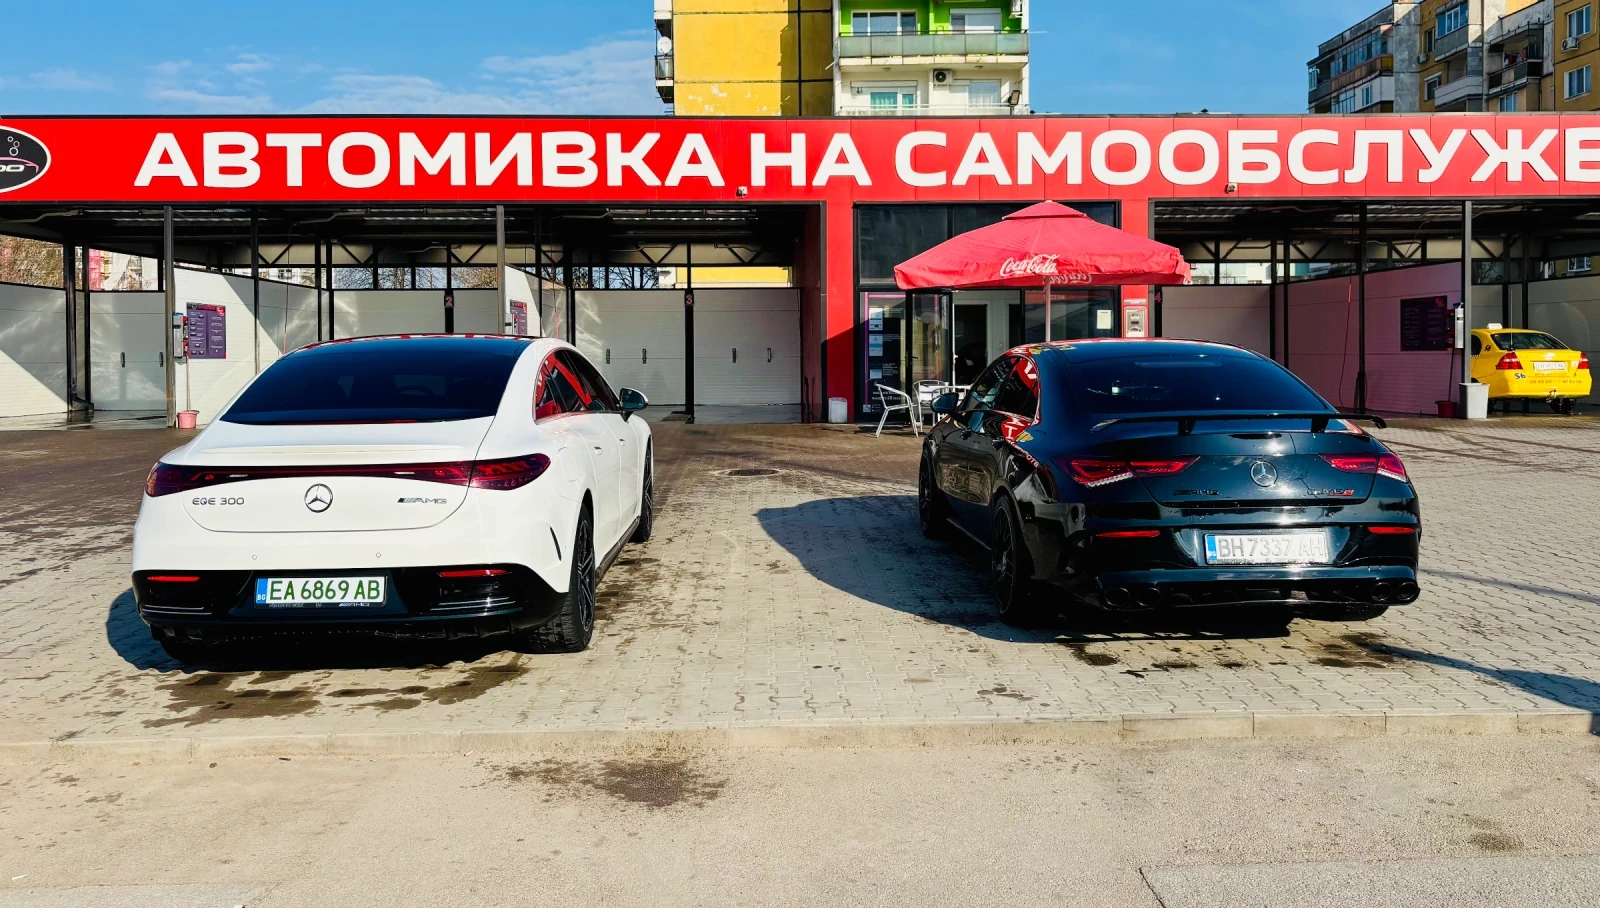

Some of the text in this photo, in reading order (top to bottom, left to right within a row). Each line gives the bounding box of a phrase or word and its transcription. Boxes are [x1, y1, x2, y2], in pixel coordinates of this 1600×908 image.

[134, 126, 1600, 188] АВТОМИВКА НА САМООБСЛУЖЕ
[1000, 253, 1060, 276] Coca-Cola
[445, 296, 453, 307] 2
[686, 294, 693, 305] 3
[1154, 292, 1162, 302] 4
[192, 497, 245, 505] EQE 300
[1219, 537, 1245, 558] BH
[1247, 537, 1294, 558] 7337
[269, 579, 381, 600] EA 6869 AB
